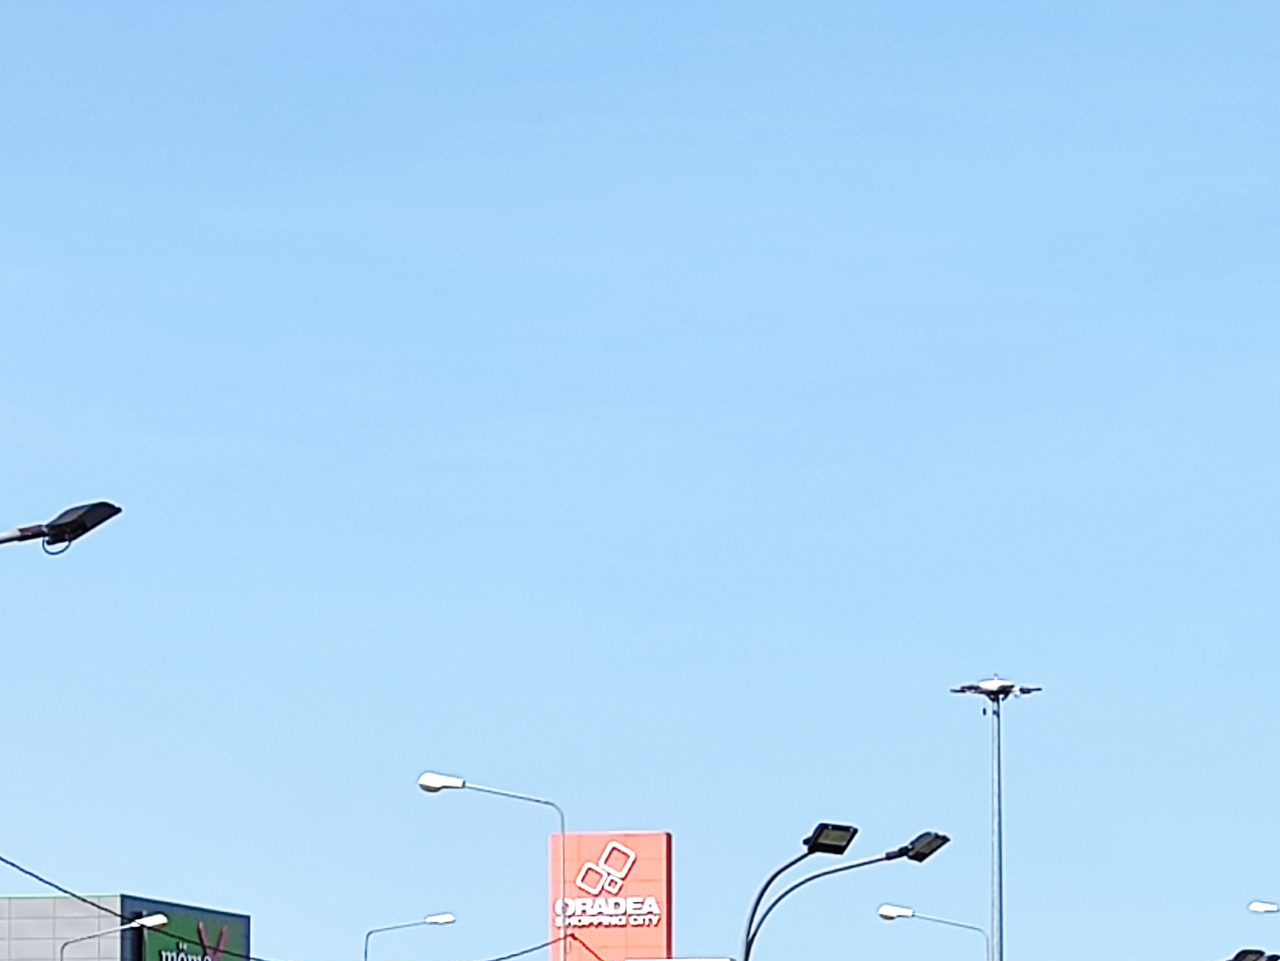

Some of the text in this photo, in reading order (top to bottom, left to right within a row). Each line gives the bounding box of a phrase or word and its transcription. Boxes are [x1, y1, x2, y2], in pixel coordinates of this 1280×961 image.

[554, 897, 661, 916] ORADEA
[554, 914, 661, 928] SHOPPING CITY
